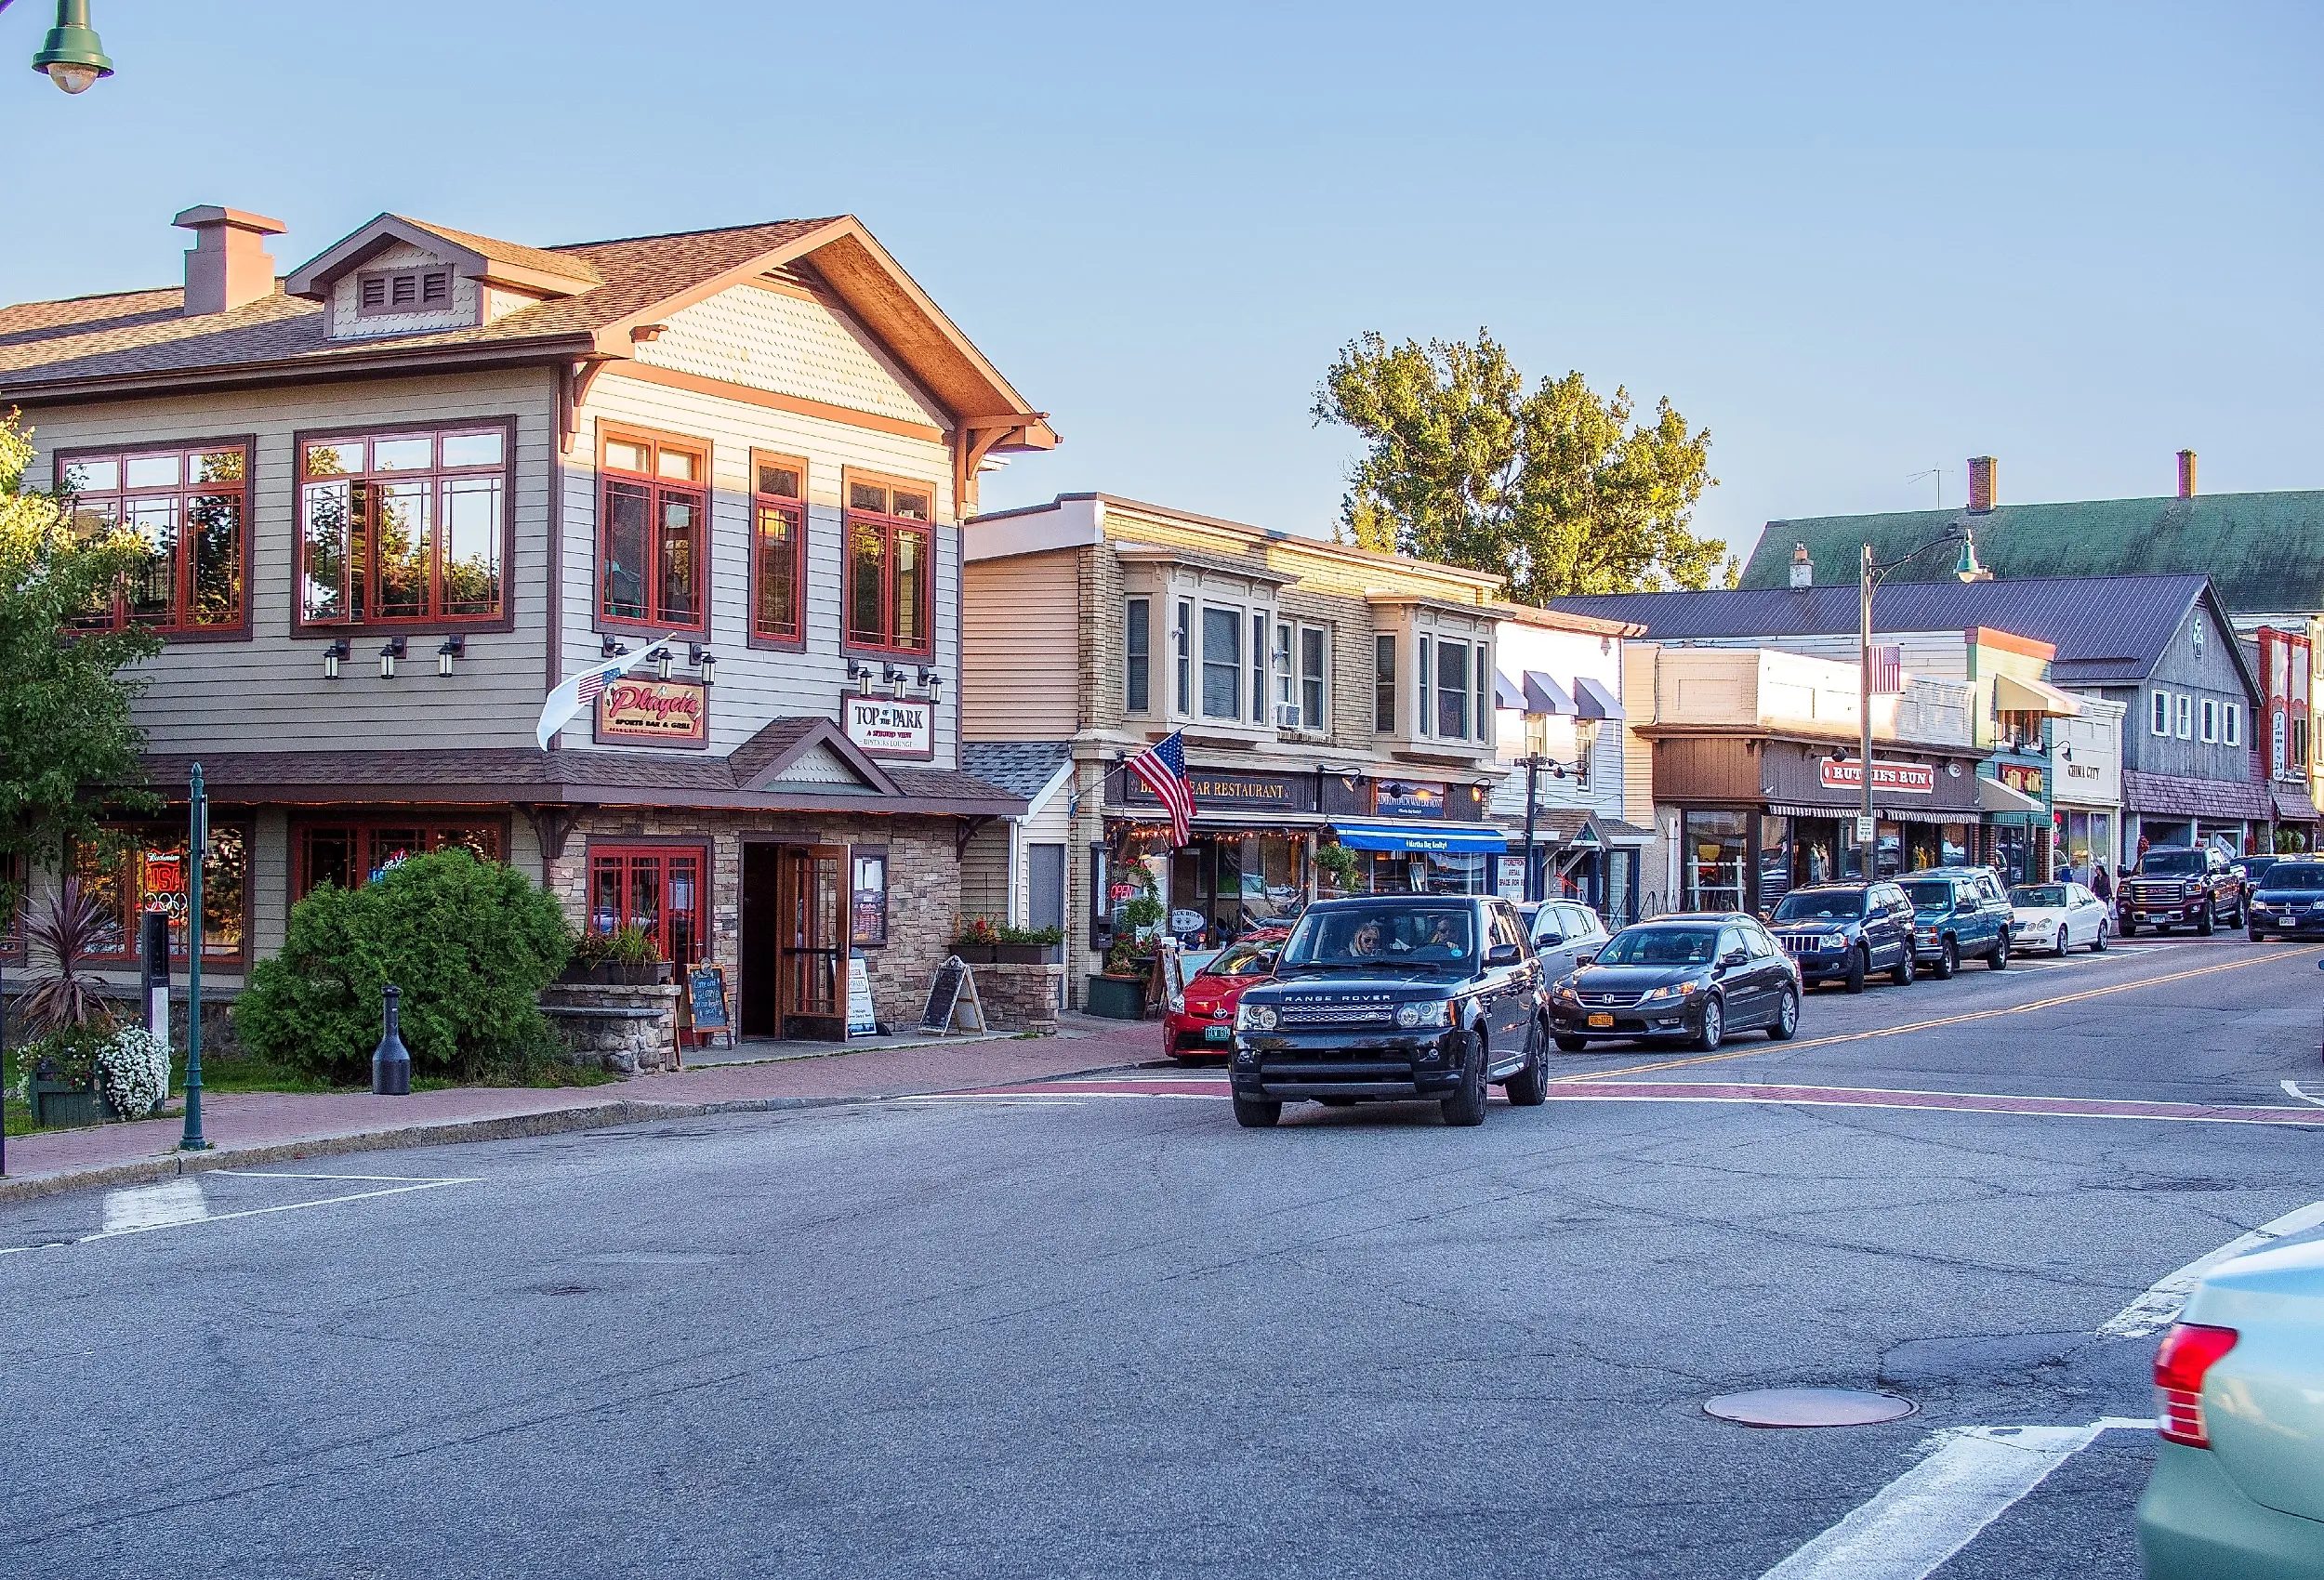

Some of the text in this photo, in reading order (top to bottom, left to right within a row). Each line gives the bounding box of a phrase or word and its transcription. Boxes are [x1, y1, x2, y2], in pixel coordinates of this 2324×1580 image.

[609, 685, 699, 720] Players
[854, 706, 879, 725] TOP
[892, 708, 924, 729] PARK
[1832, 767, 1926, 784] RUTIE'S RUN
[2067, 764, 2100, 780] CHINA CITY
[1191, 781, 1284, 798] EAR RESTAURANT
[146, 867, 185, 891] USA
[1111, 885, 1133, 899] OPEN
